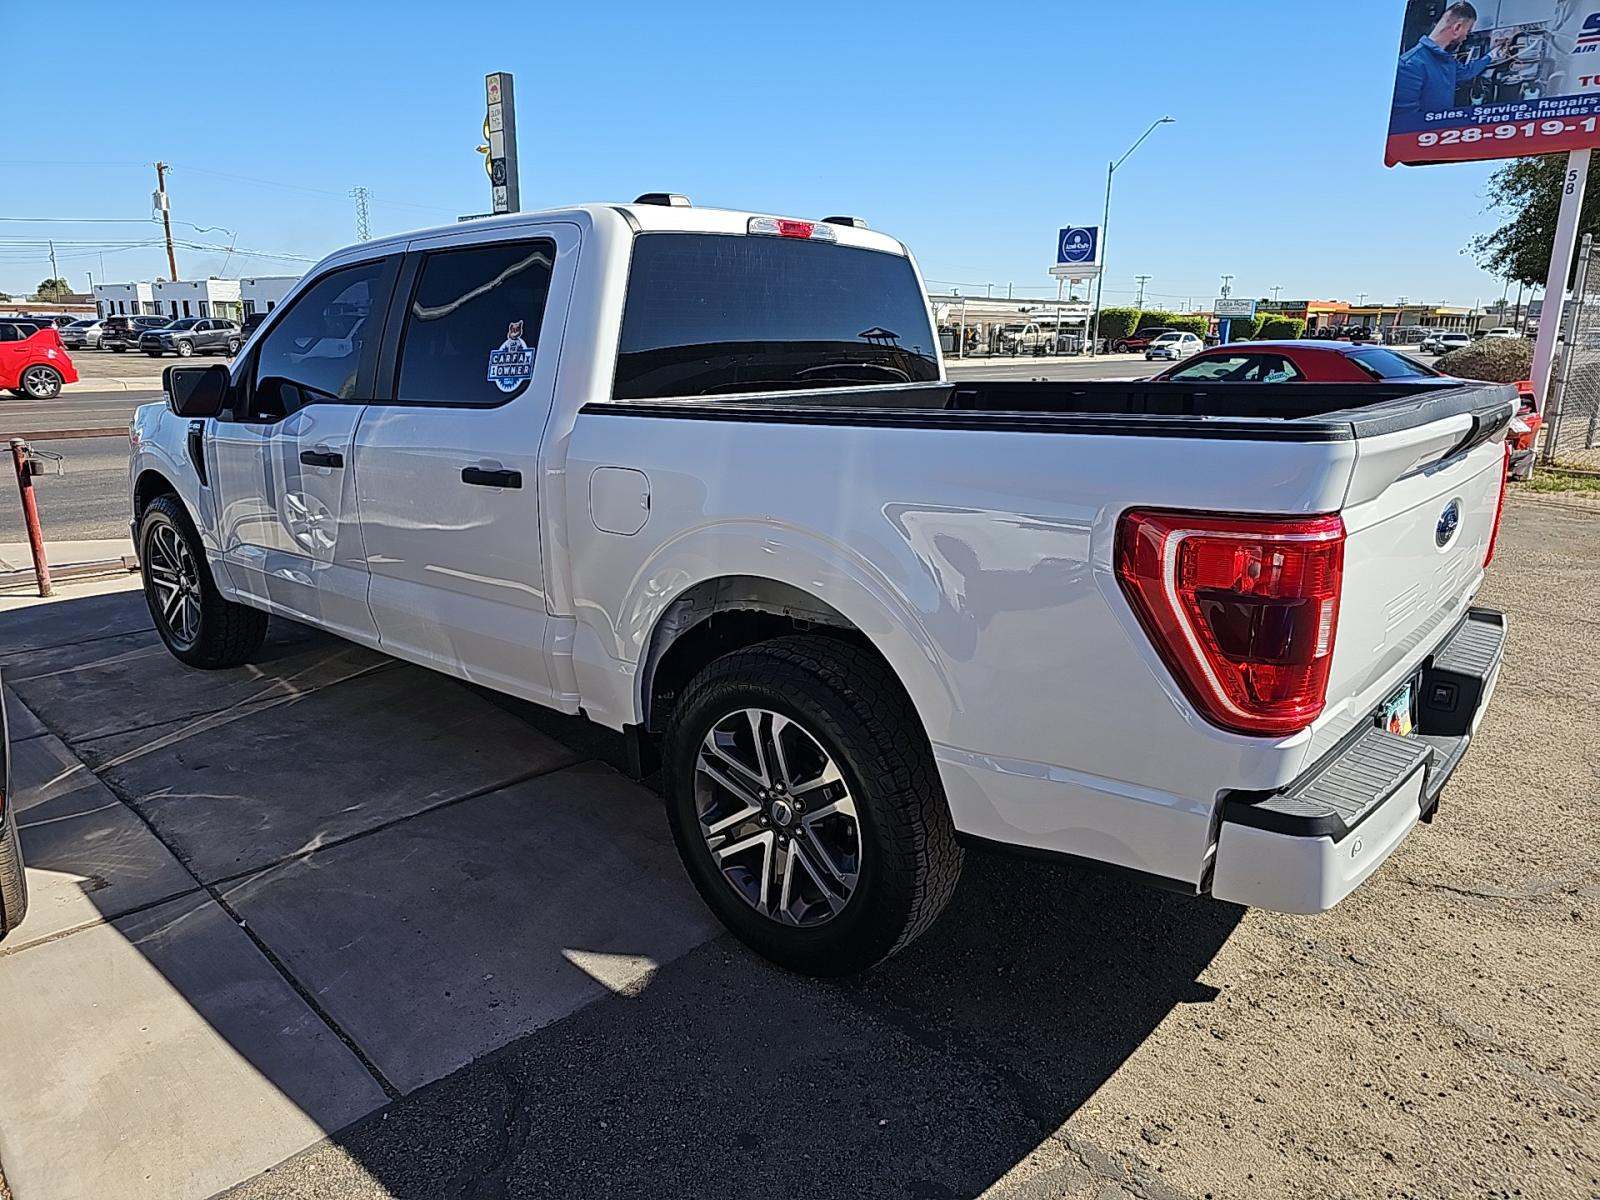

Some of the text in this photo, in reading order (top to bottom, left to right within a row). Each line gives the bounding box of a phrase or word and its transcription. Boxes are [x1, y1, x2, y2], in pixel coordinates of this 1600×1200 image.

[1571, 44, 1597, 54] AIR
[1515, 106, 1589, 120] Estimates
[1417, 117, 1597, 147] 928-919-1
[493, 351, 532, 363] CARFAX
[498, 365, 529, 375] OWNER
